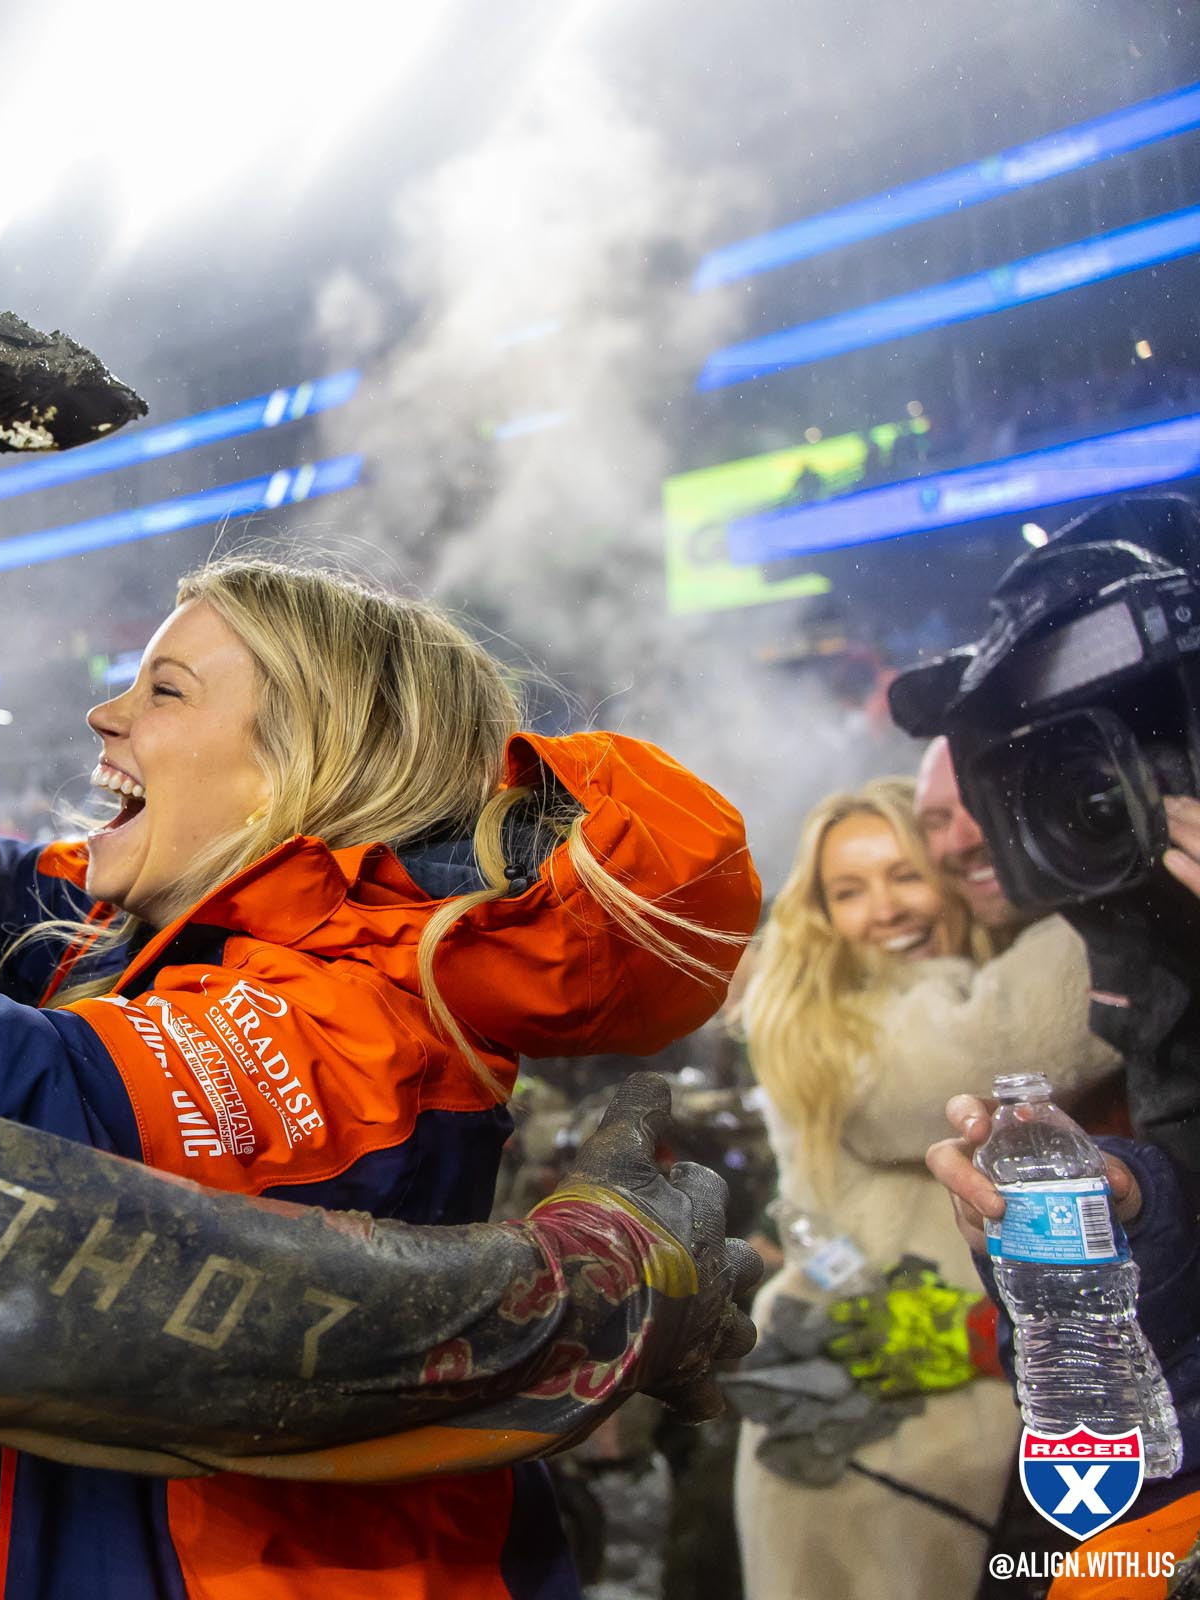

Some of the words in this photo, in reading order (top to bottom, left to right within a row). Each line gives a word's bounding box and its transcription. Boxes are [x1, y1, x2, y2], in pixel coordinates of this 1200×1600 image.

[179, 1040, 191, 1058] WE
[189, 1057, 208, 1084] BUILD
[204, 1083, 234, 1152] CHAMPIONSHIP
[209, 1006, 259, 1075] CHEVROLET
[219, 979, 324, 1136] PARADISE
